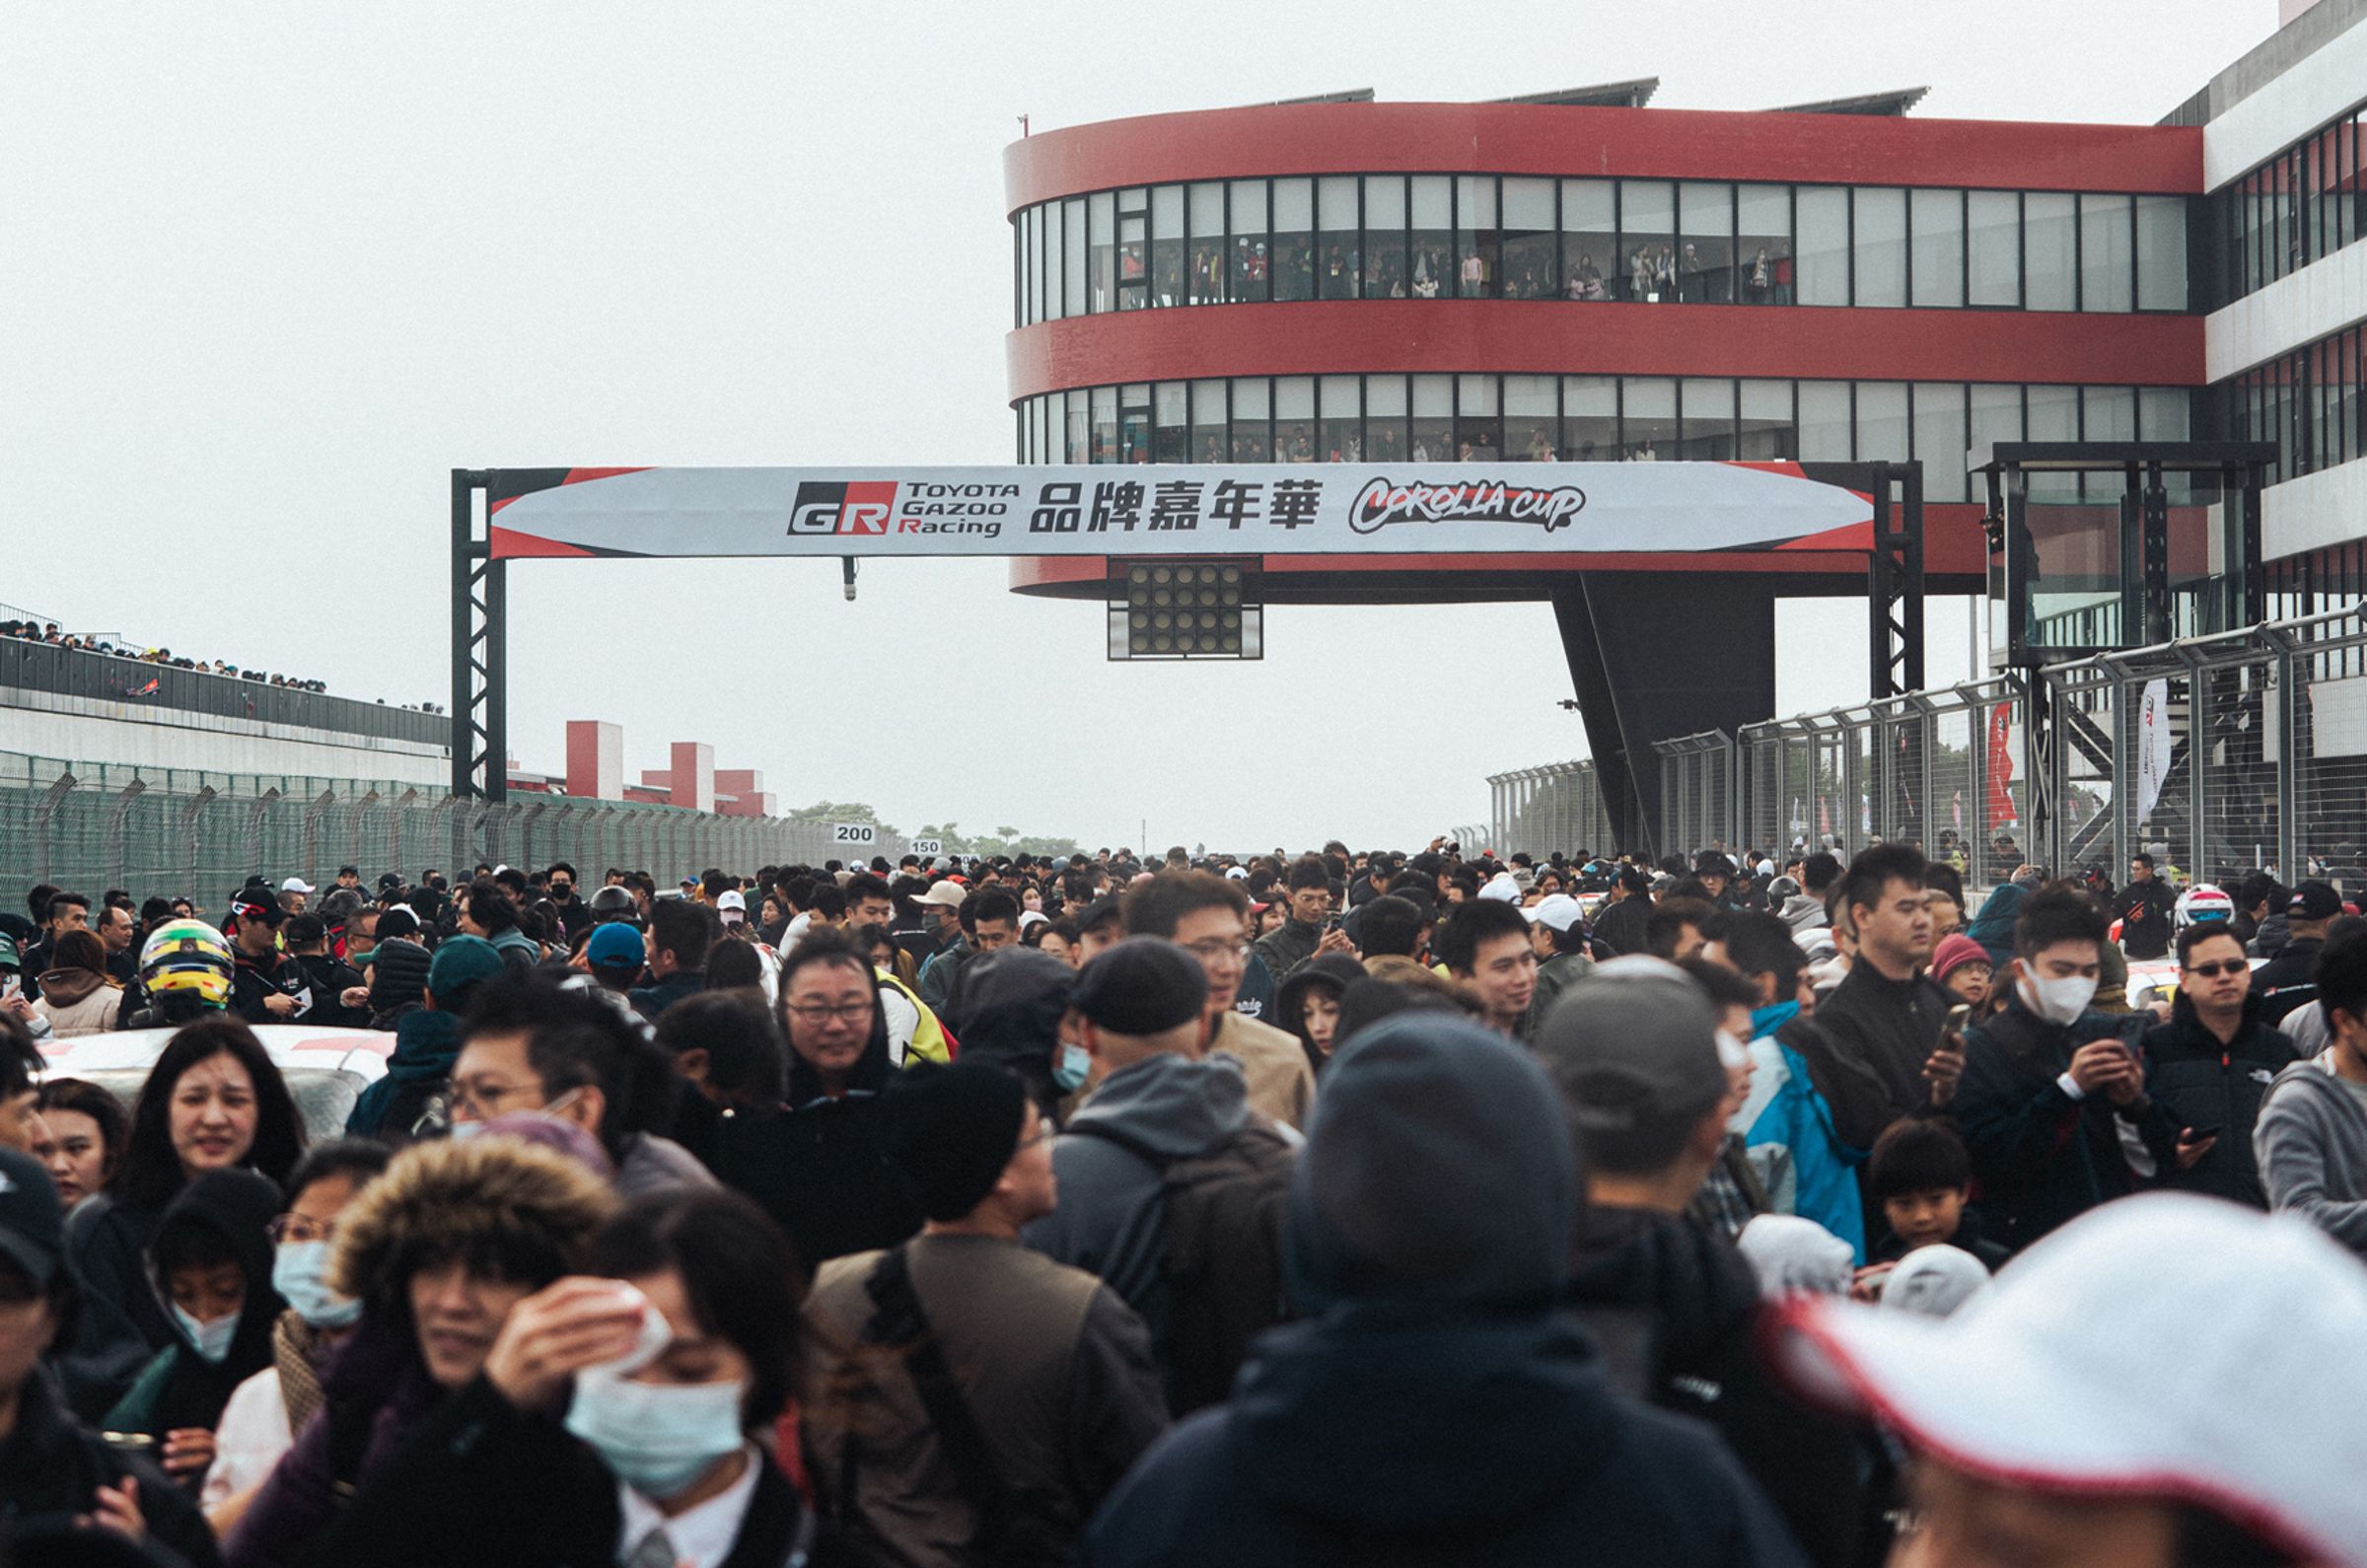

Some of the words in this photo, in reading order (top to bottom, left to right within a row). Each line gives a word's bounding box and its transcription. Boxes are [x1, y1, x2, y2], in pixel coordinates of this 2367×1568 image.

[906, 481, 1020, 497] TOYOTA
[902, 501, 1007, 516] GAZOO
[1030, 479, 1324, 533] 品牌嘉年華
[1350, 477, 1505, 532] COROLLA
[791, 502, 891, 535] GR
[897, 518, 1002, 537] Racing
[837, 826, 872, 841] 200
[911, 841, 939, 853] 150
